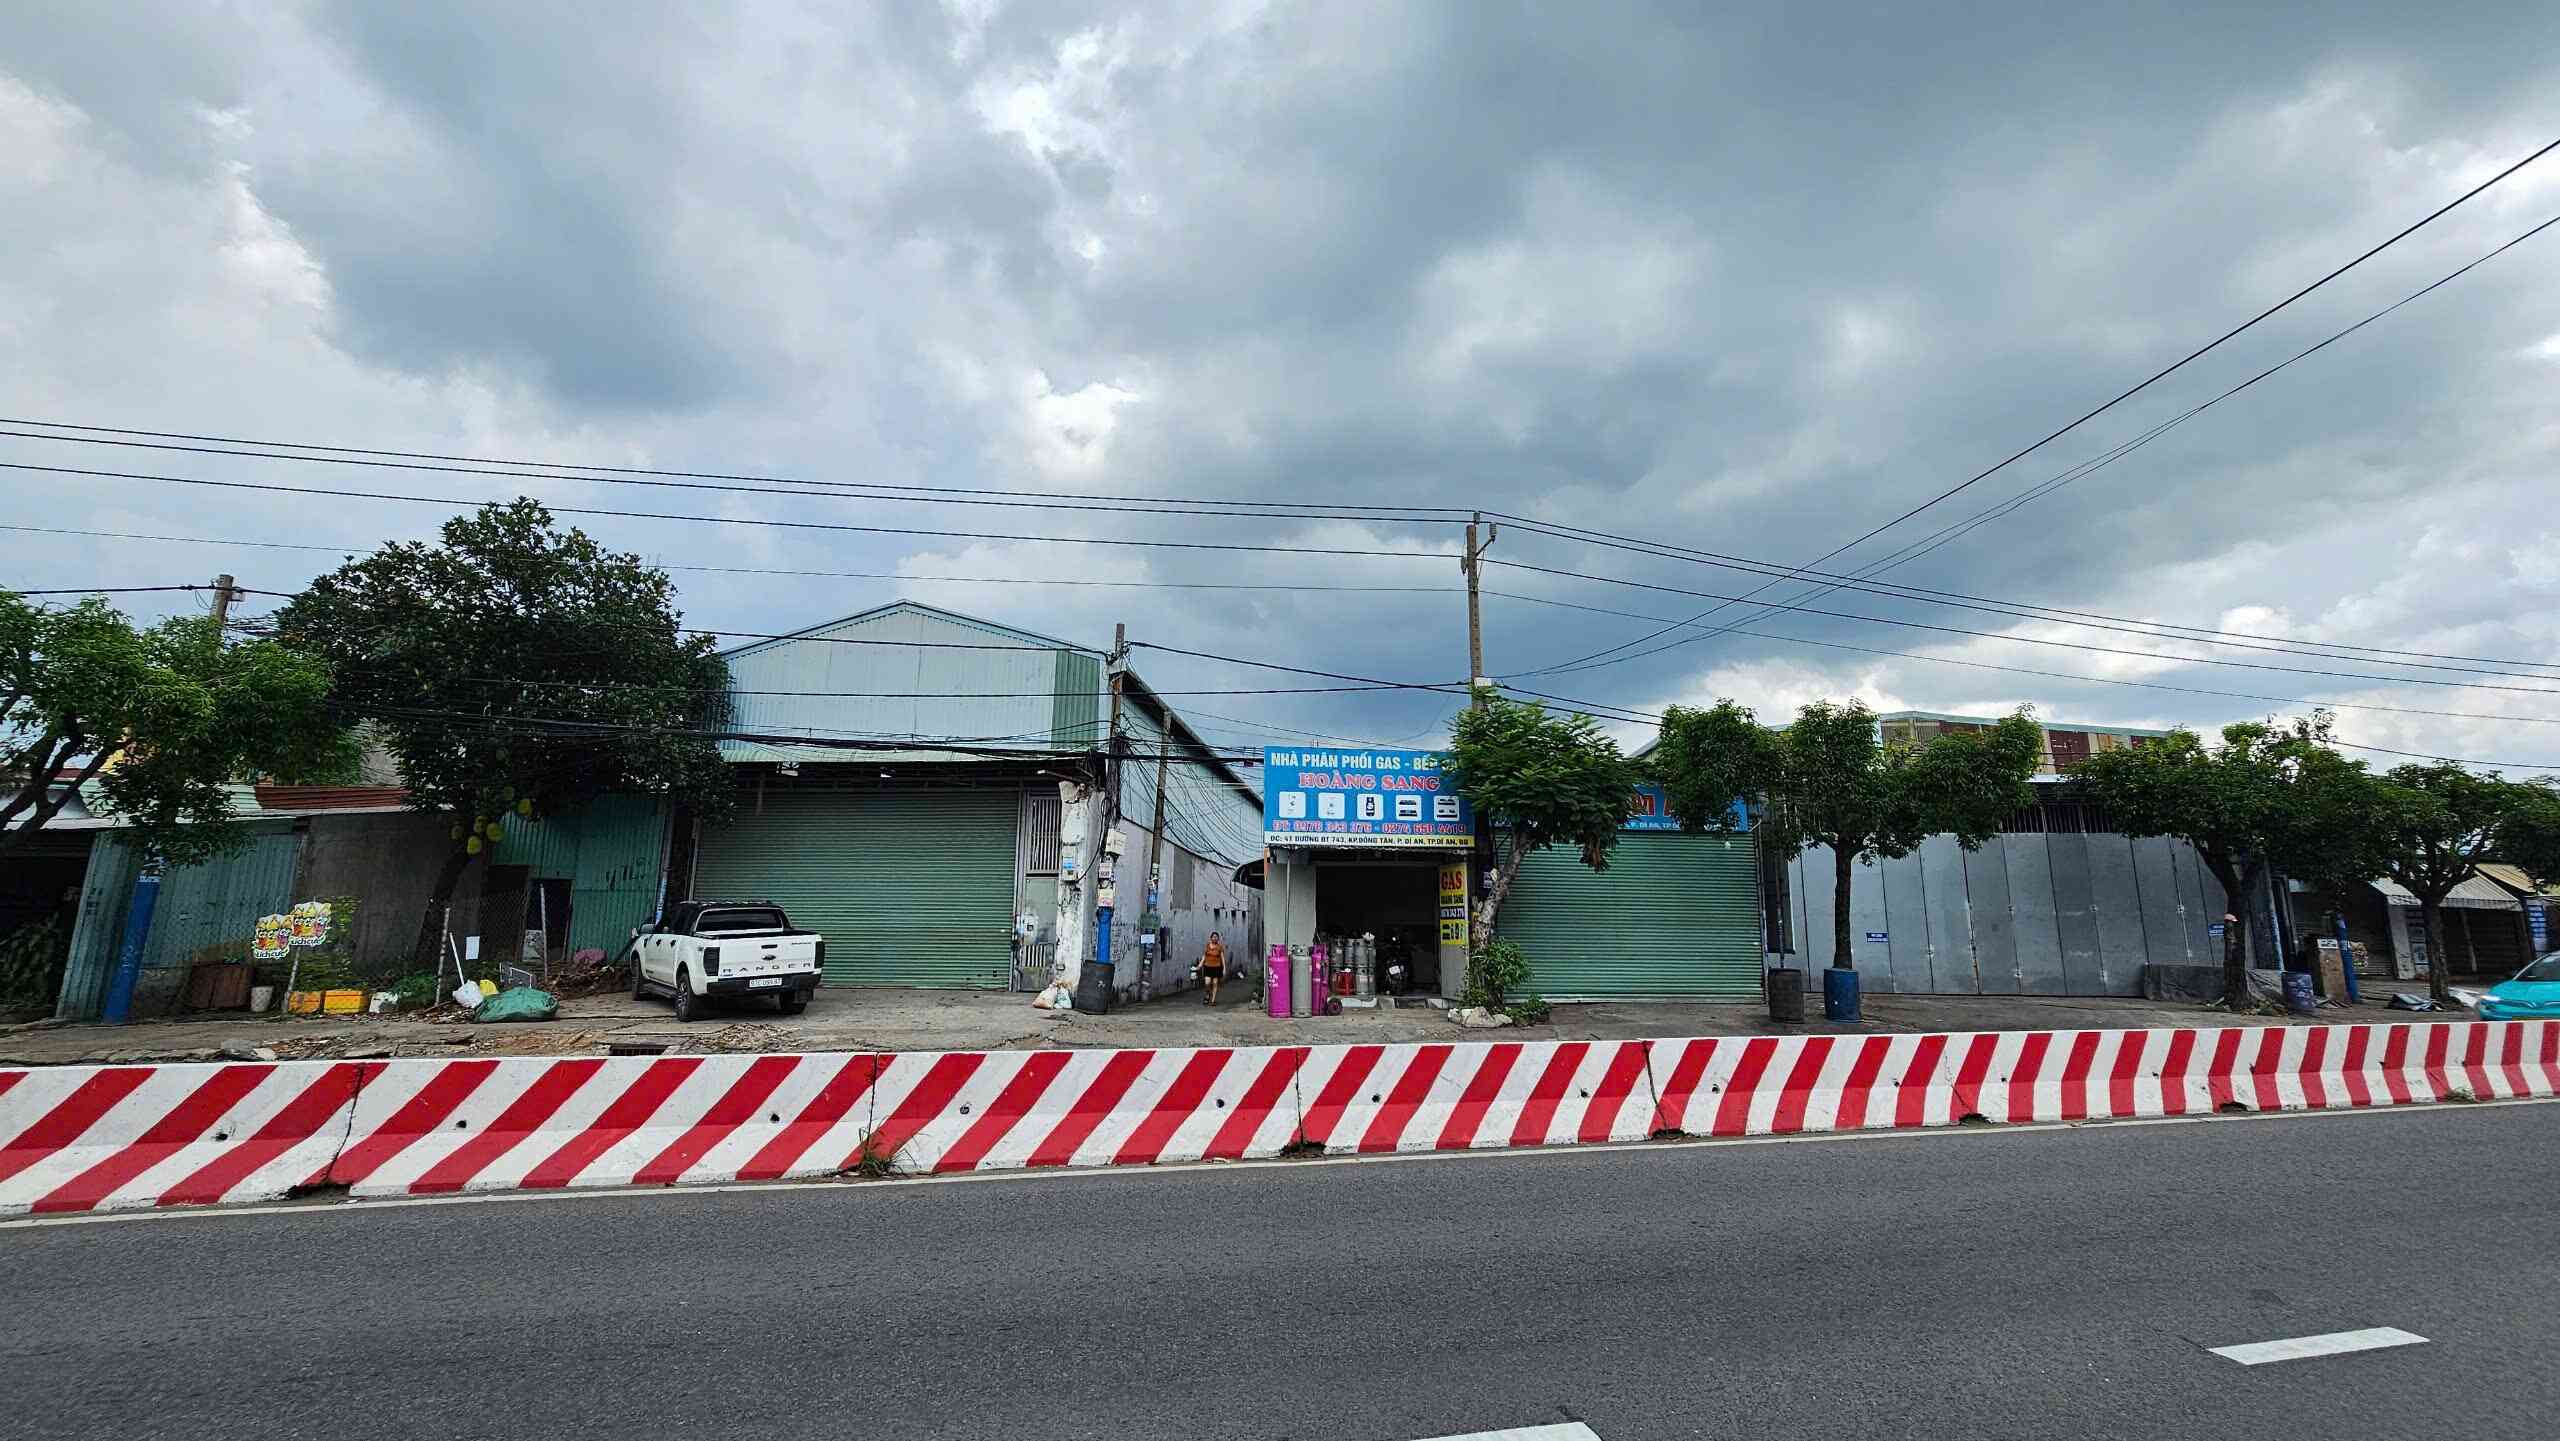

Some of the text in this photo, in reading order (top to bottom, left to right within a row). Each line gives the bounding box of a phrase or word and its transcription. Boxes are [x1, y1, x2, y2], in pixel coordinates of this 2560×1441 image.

[1271, 751, 1298, 767] NHÀ
[1302, 752, 1338, 768] PHÂN
[1342, 751, 1372, 769] PHỐI
[1376, 756, 1400, 770] GAS
[1298, 769, 1440, 792] HOÀNG SANG
[1441, 871, 1463, 891] GAS
[722, 962, 811, 973] RANGER
